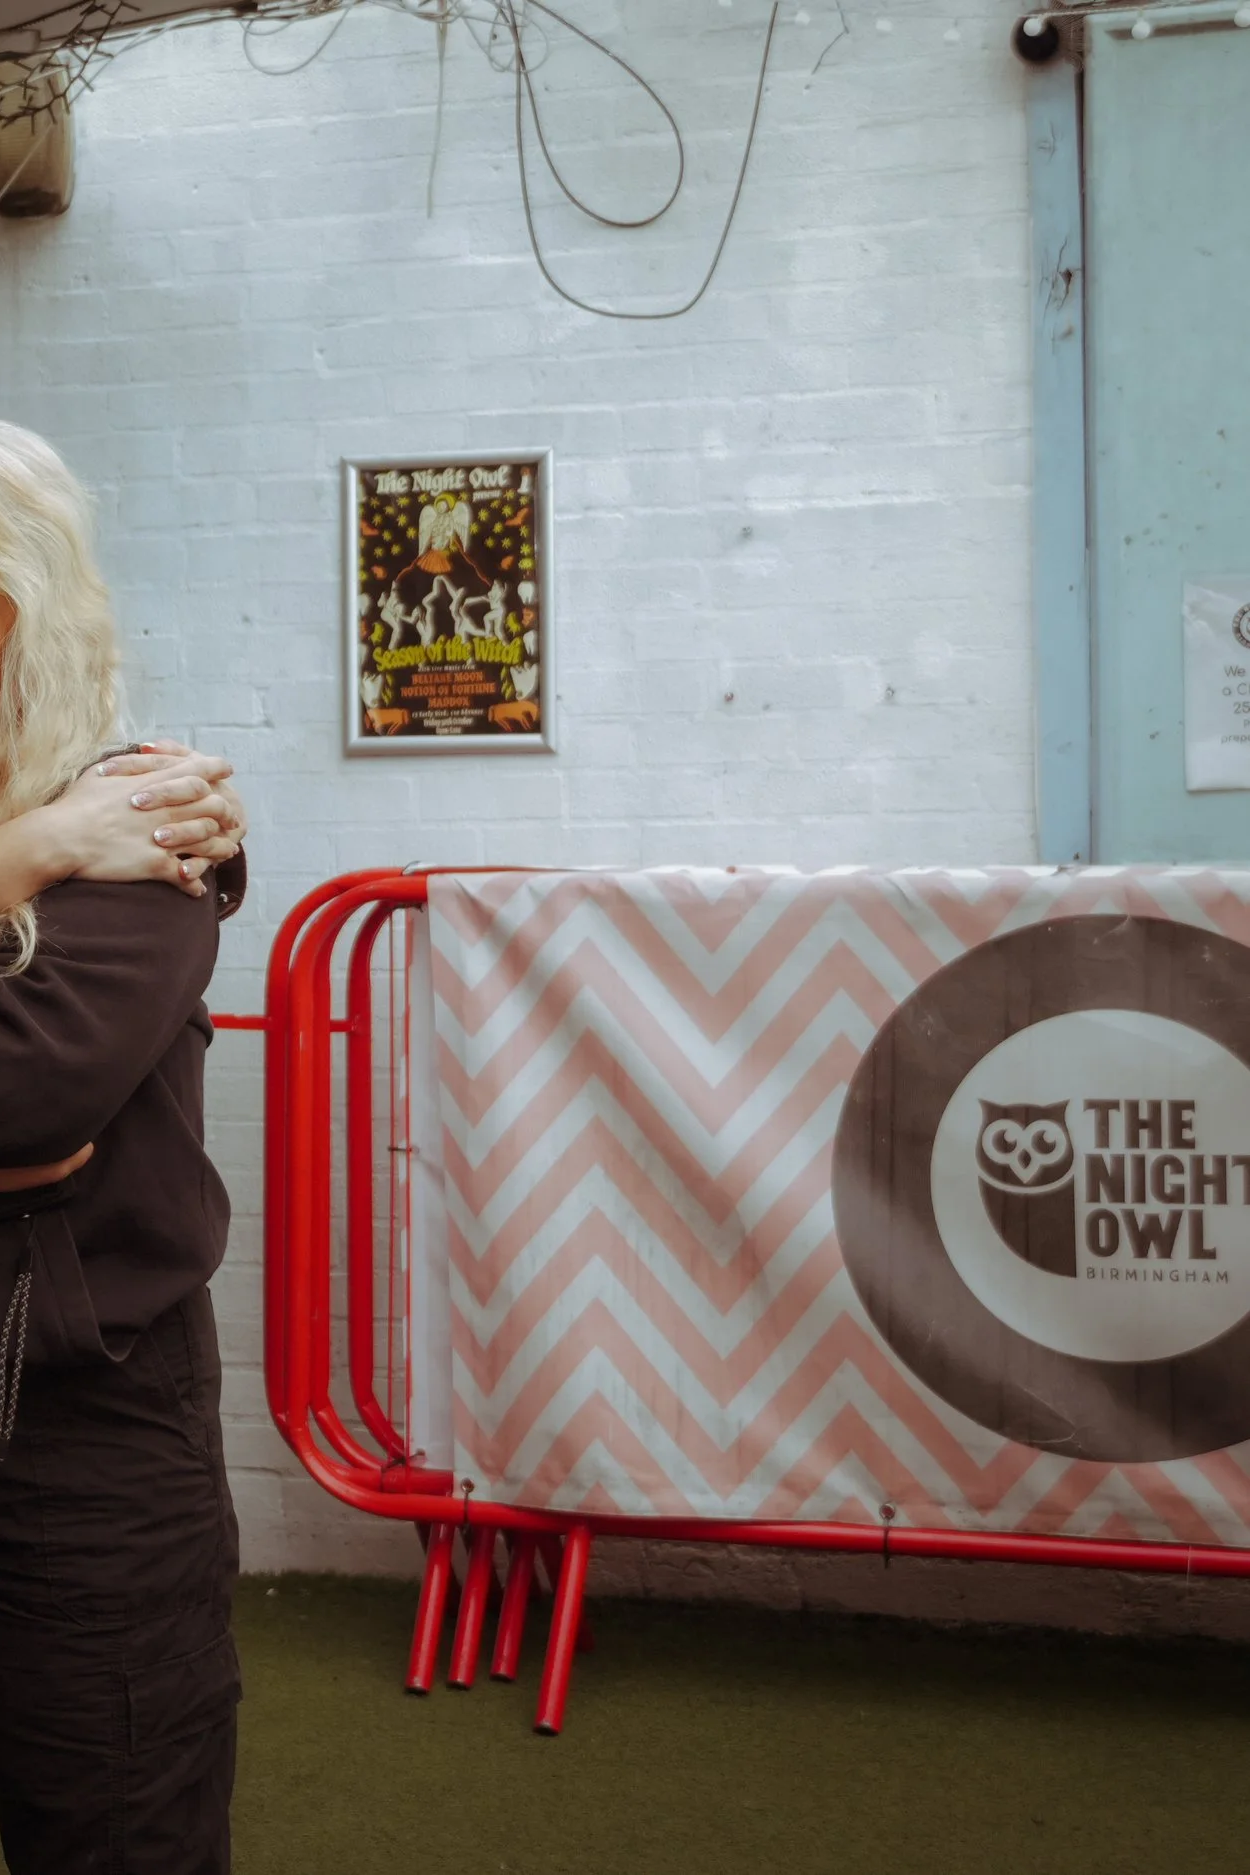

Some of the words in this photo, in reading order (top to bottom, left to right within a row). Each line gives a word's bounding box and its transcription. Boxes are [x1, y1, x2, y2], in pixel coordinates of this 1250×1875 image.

[374, 471, 409, 494] The
[411, 467, 466, 497] Night
[469, 464, 510, 489] Owl
[372, 645, 426, 672] Season
[426, 634, 445, 663] of
[446, 633, 472, 662] the
[473, 636, 523, 665] Witch
[453, 671, 484, 683] MOON
[1223, 665, 1247, 677] We
[400, 686, 436, 697] NOTION
[452, 682, 496, 695] FORTUNE
[428, 696, 471, 708] MADDOX
[1083, 1099, 1196, 1149] THE
[1085, 1208, 1217, 1260] OWL
[1086, 1266, 1229, 1284] BIRMINGHAM
